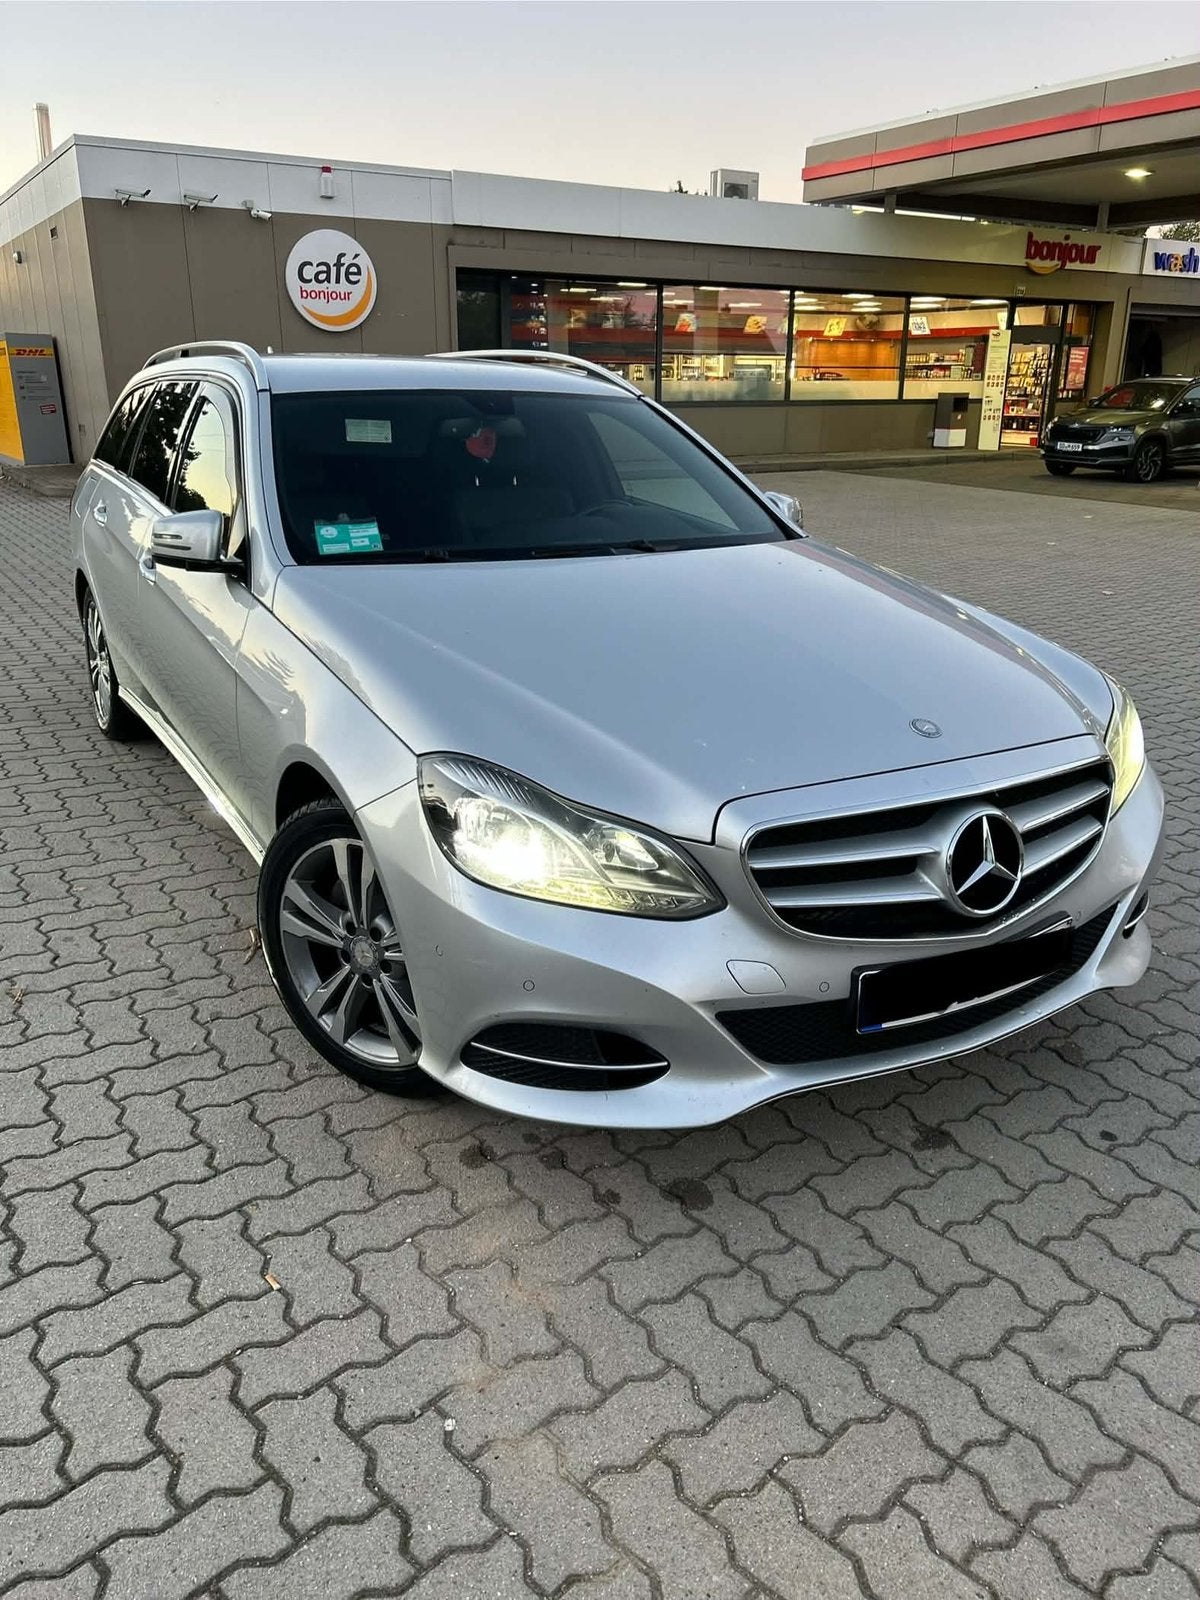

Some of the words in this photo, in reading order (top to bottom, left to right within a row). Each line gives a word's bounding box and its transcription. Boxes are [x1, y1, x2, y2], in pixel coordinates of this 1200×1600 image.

[1025, 231, 1101, 269] bonjour
[1154, 247, 1200, 273] wash
[297, 252, 362, 285] café
[299, 285, 353, 304] bonjour
[15, 348, 47, 356] DHL
